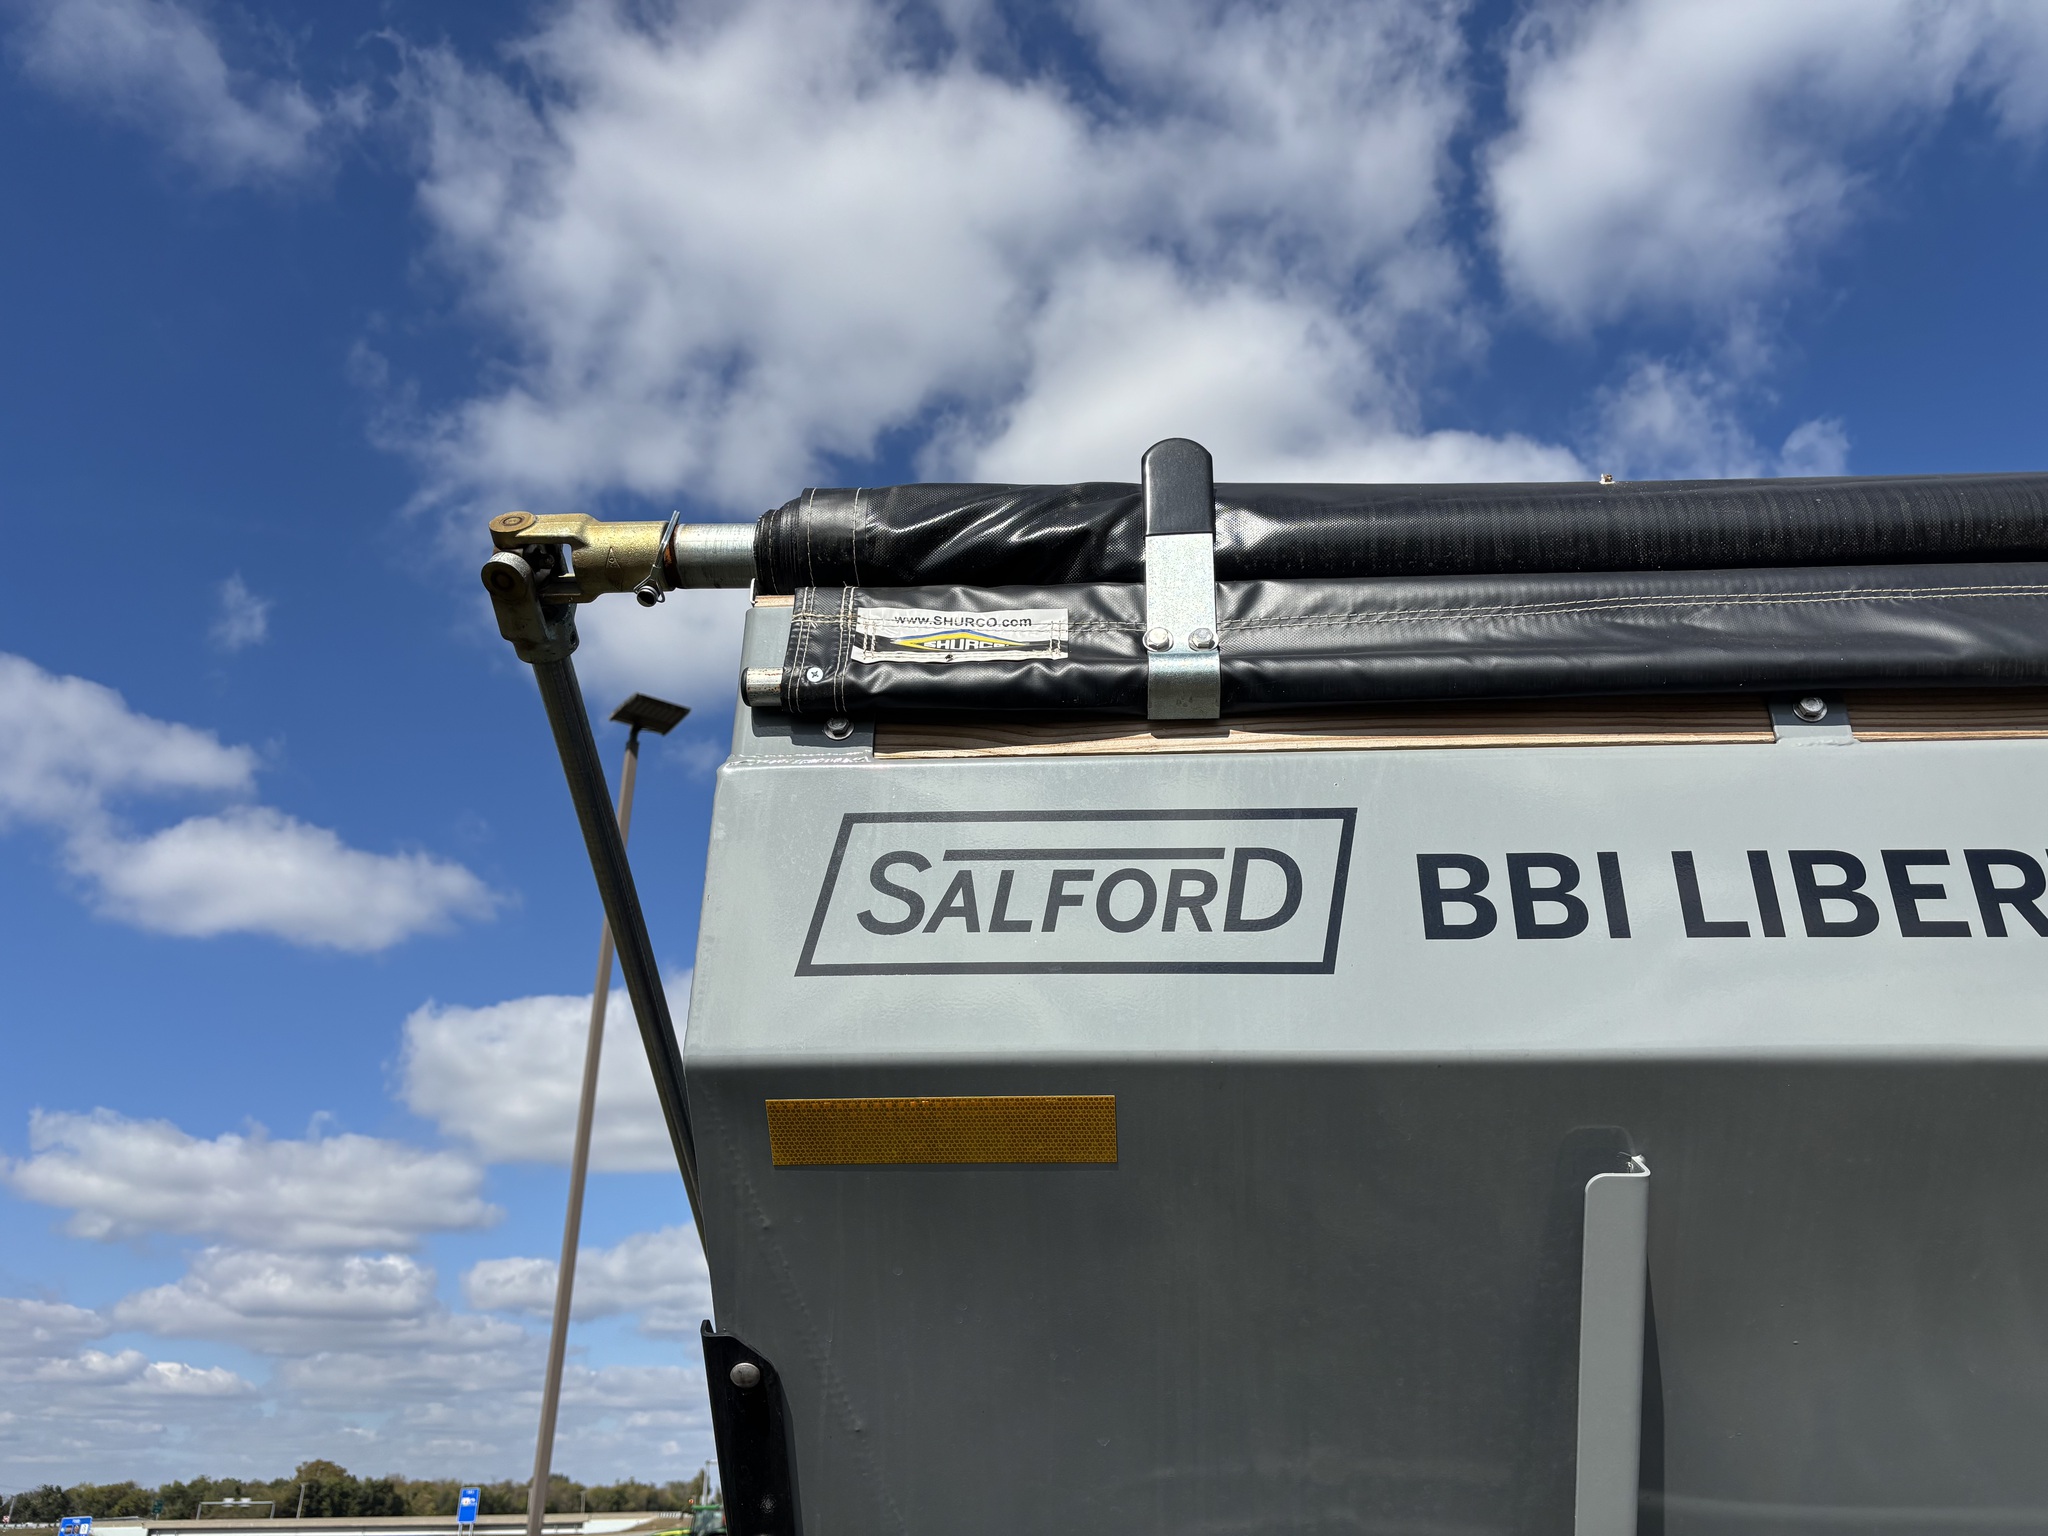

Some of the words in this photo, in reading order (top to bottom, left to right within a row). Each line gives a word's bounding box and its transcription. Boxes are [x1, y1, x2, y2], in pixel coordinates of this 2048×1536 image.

[894, 615, 1032, 628] www.SHURCO.com
[857, 847, 1302, 935] SALFORD
[1416, 852, 1632, 939] BBI
[1671, 849, 2048, 938] LIBER
